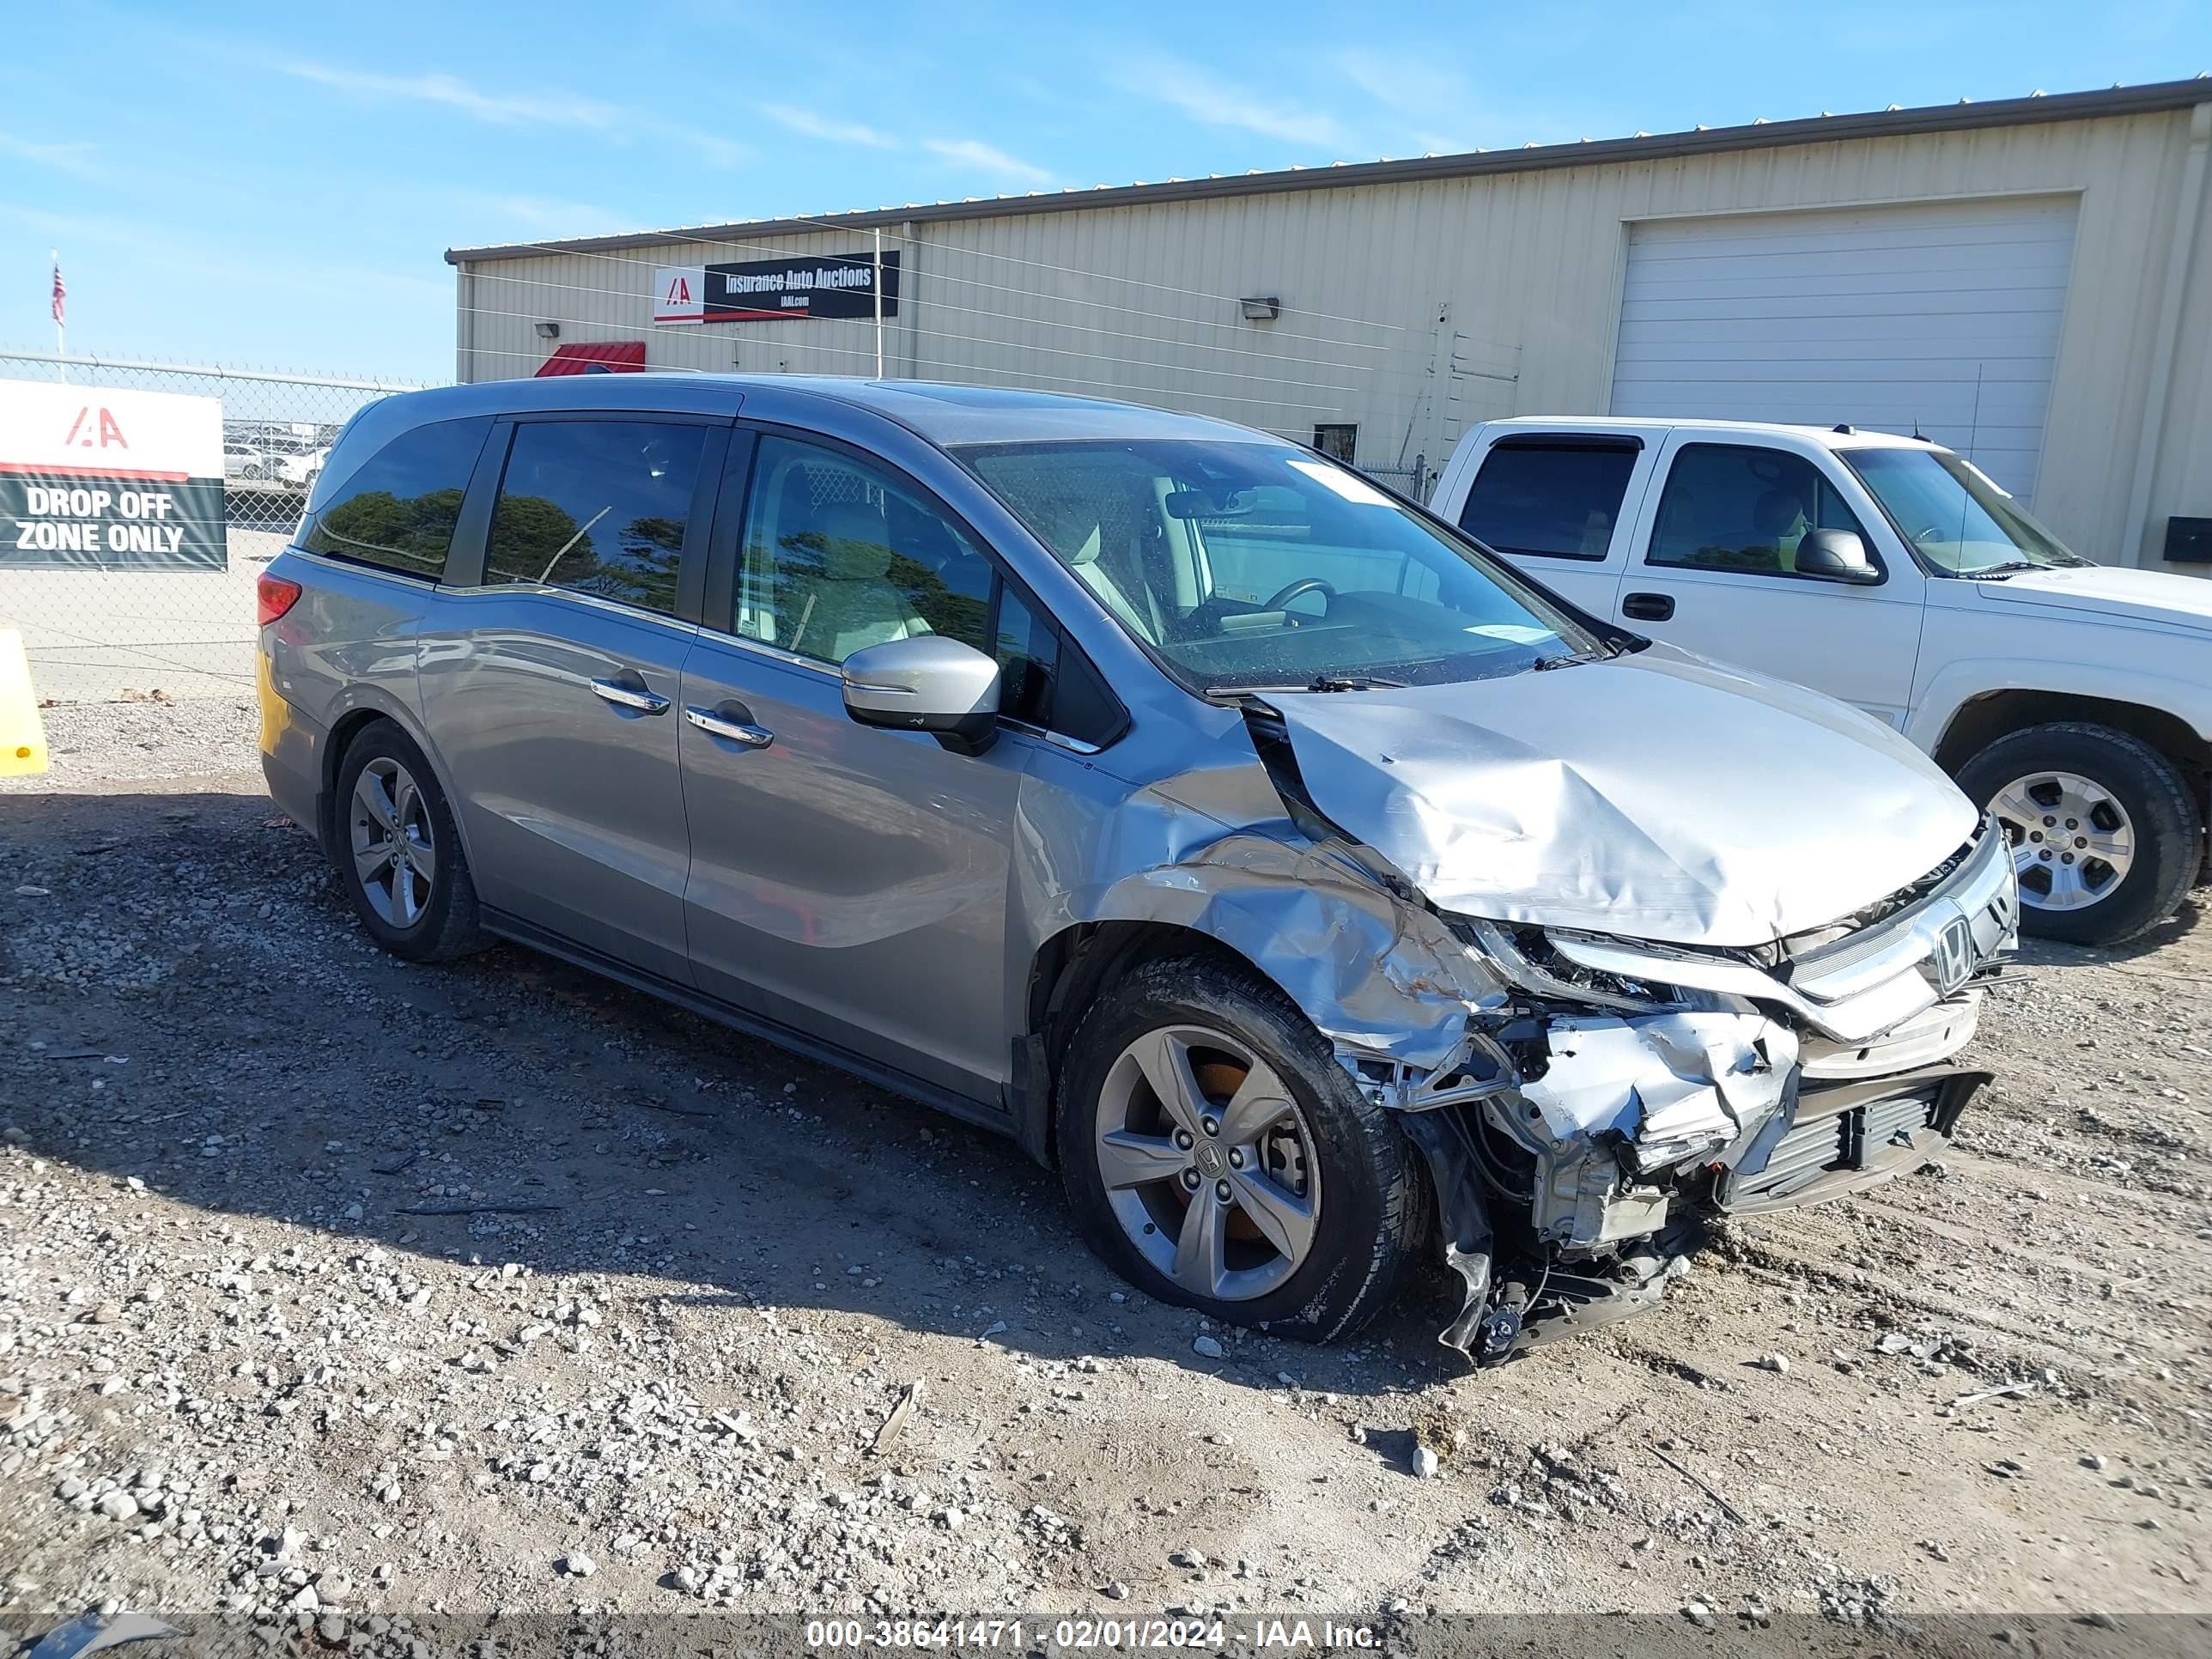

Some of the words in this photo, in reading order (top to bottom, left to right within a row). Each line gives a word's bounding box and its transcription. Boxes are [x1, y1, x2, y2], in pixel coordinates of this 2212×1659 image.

[725, 273, 784, 295] Insurance
[786, 270, 814, 290] Auto
[815, 266, 872, 289] Auctions
[27, 487, 112, 518] DROP
[119, 491, 173, 520] OFF
[15, 520, 101, 552] ZONE
[108, 524, 185, 553] ONLY
